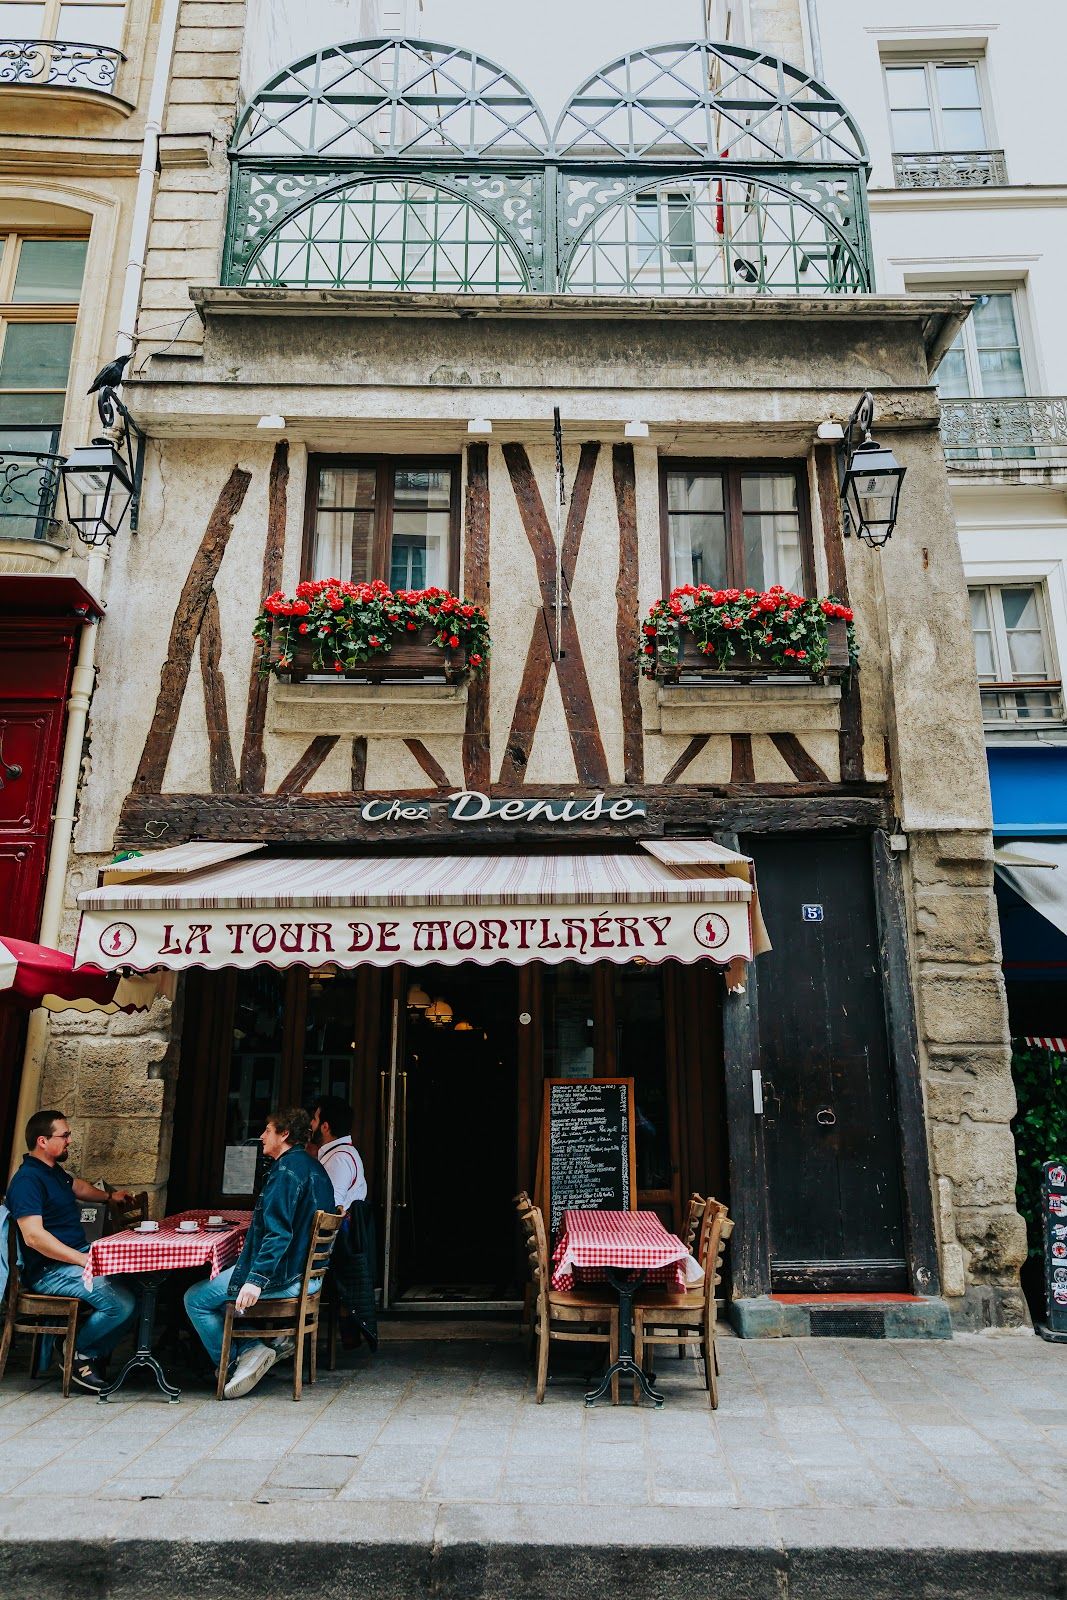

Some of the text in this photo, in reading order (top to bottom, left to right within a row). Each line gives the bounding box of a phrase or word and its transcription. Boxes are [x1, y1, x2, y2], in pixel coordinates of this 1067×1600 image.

[361, 791, 647, 822] Chez Denise
[807, 907, 818, 919] 5
[160, 924, 213, 955] LA
[225, 923, 334, 954] TOUR
[346, 922, 401, 953] DE
